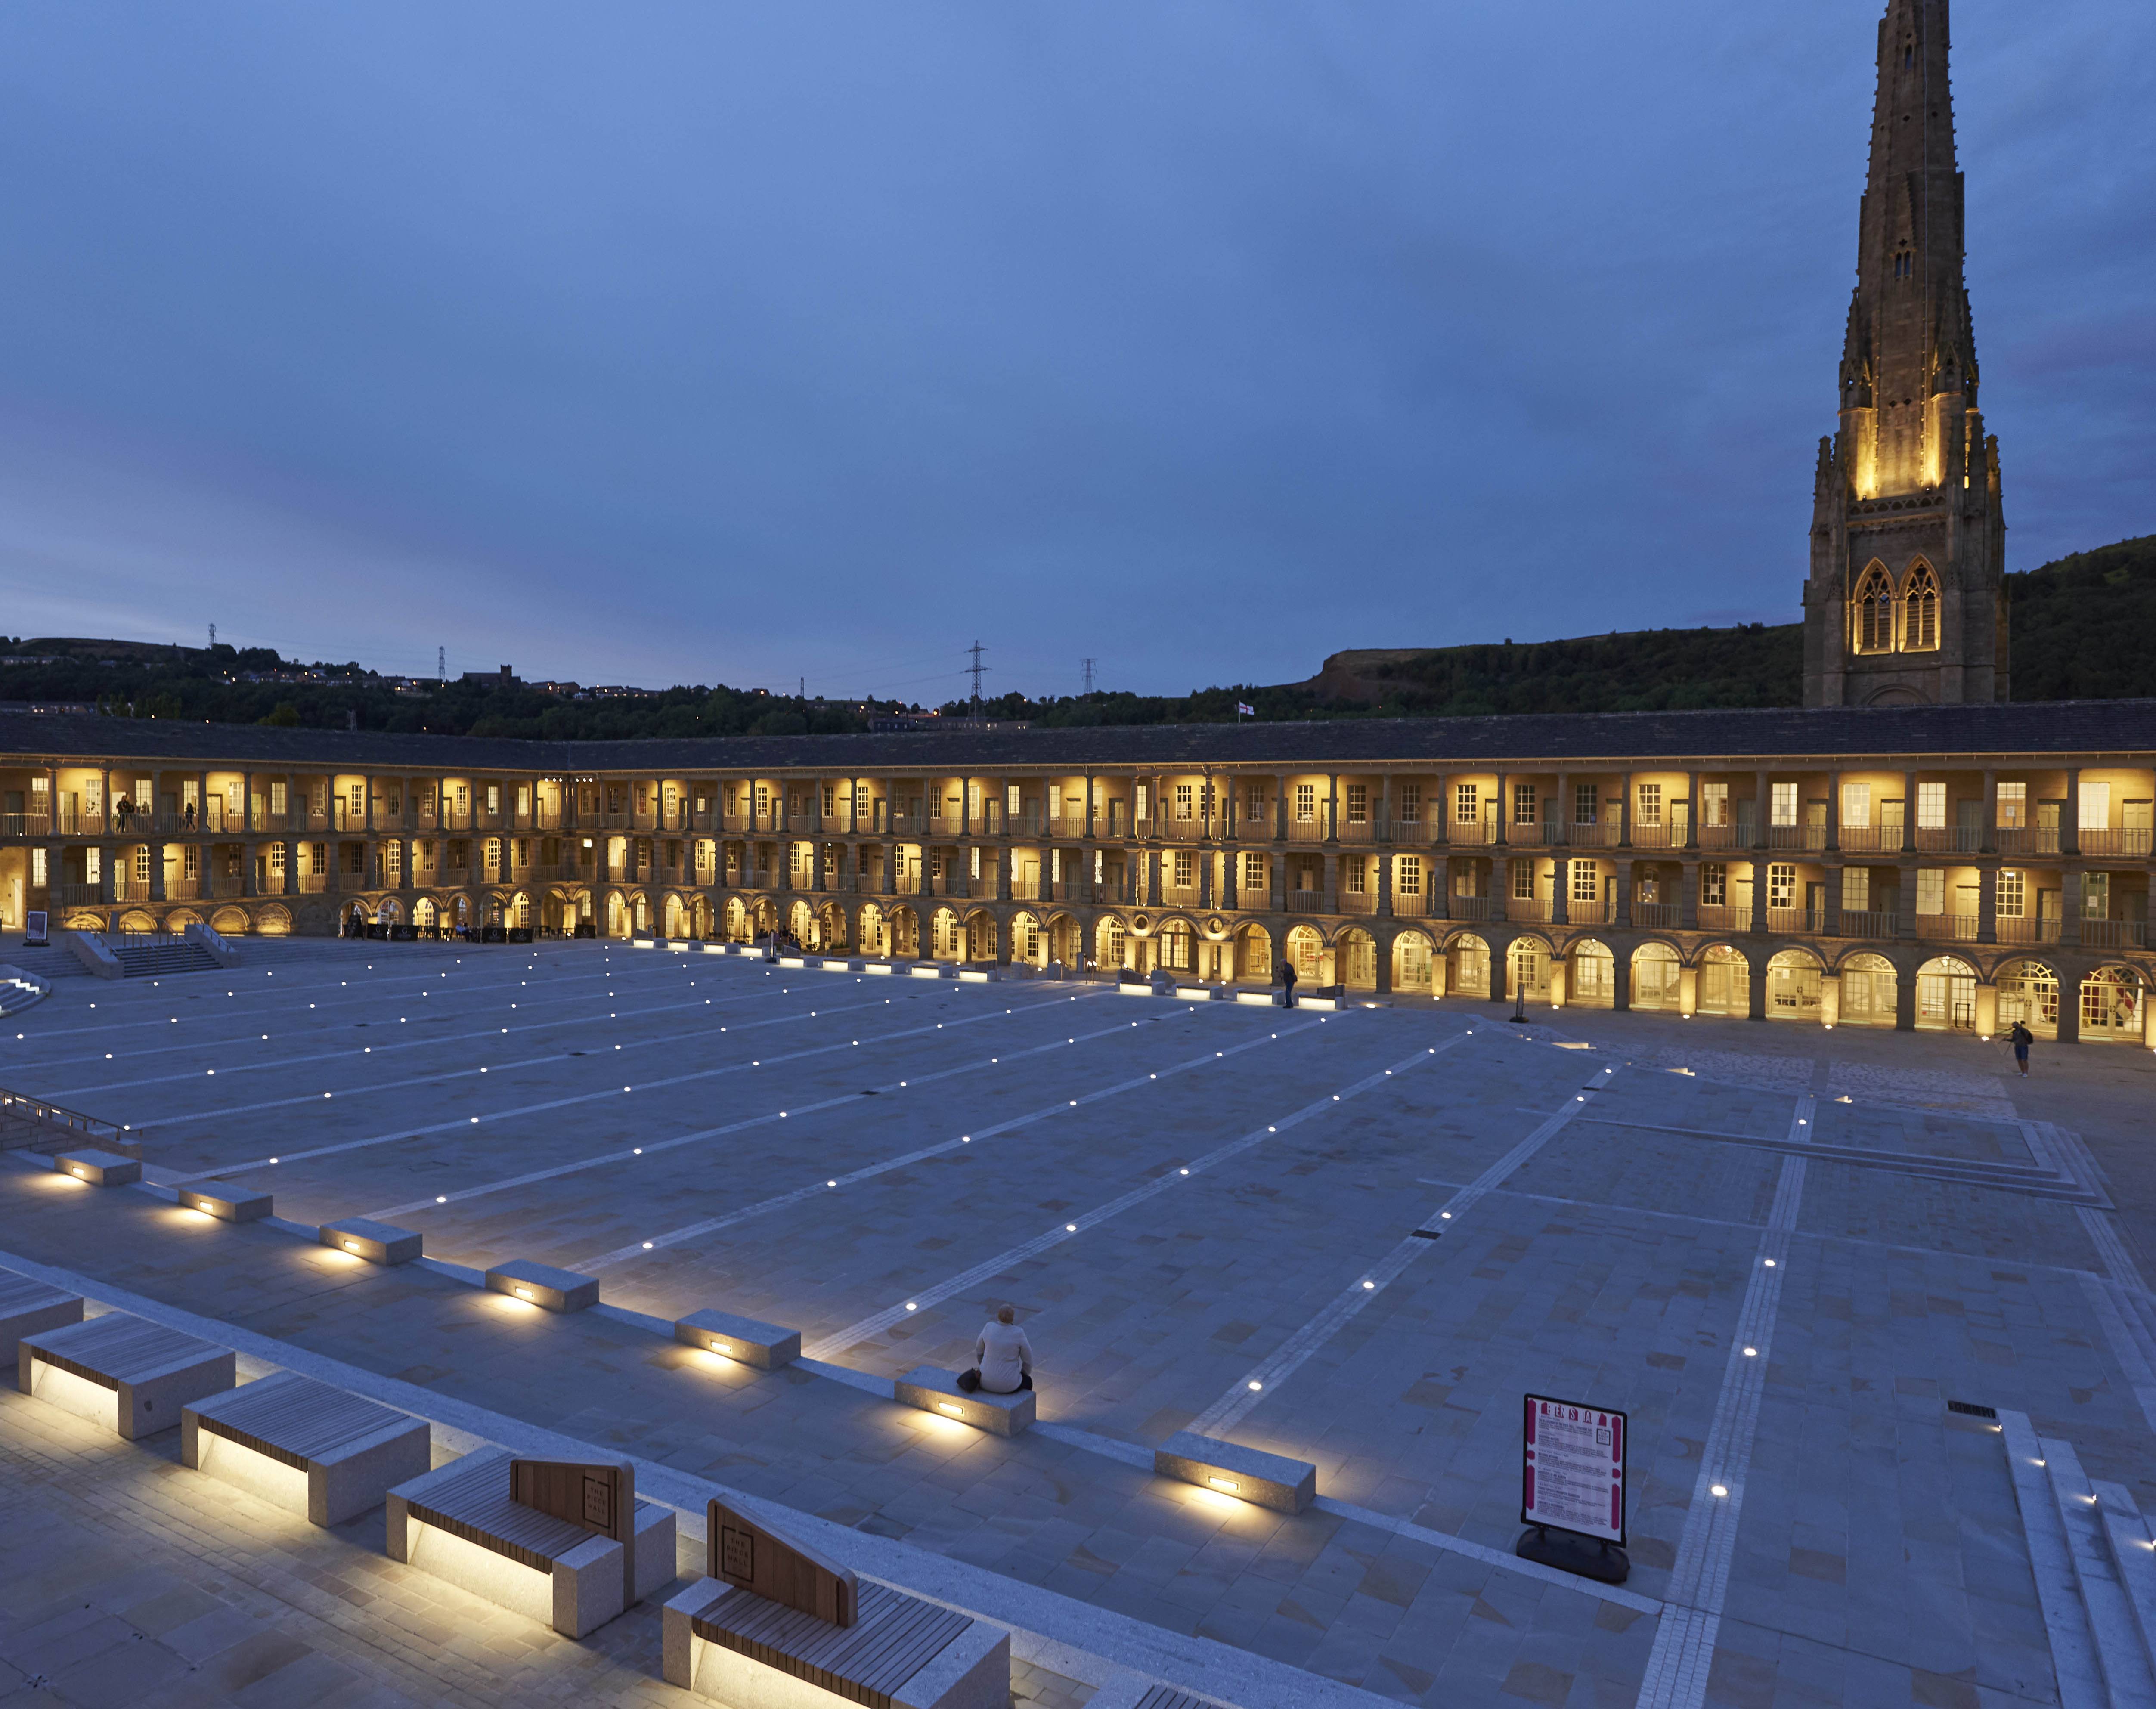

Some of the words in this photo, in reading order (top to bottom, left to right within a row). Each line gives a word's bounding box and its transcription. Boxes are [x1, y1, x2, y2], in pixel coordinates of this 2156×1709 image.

[591, 1488, 603, 1497] THE
[587, 1494, 606, 1506] PIECE
[588, 1503, 606, 1515] HALL
[731, 1538, 744, 1548] THE
[727, 1545, 748, 1558] PIECE
[728, 1554, 748, 1567] HALL
